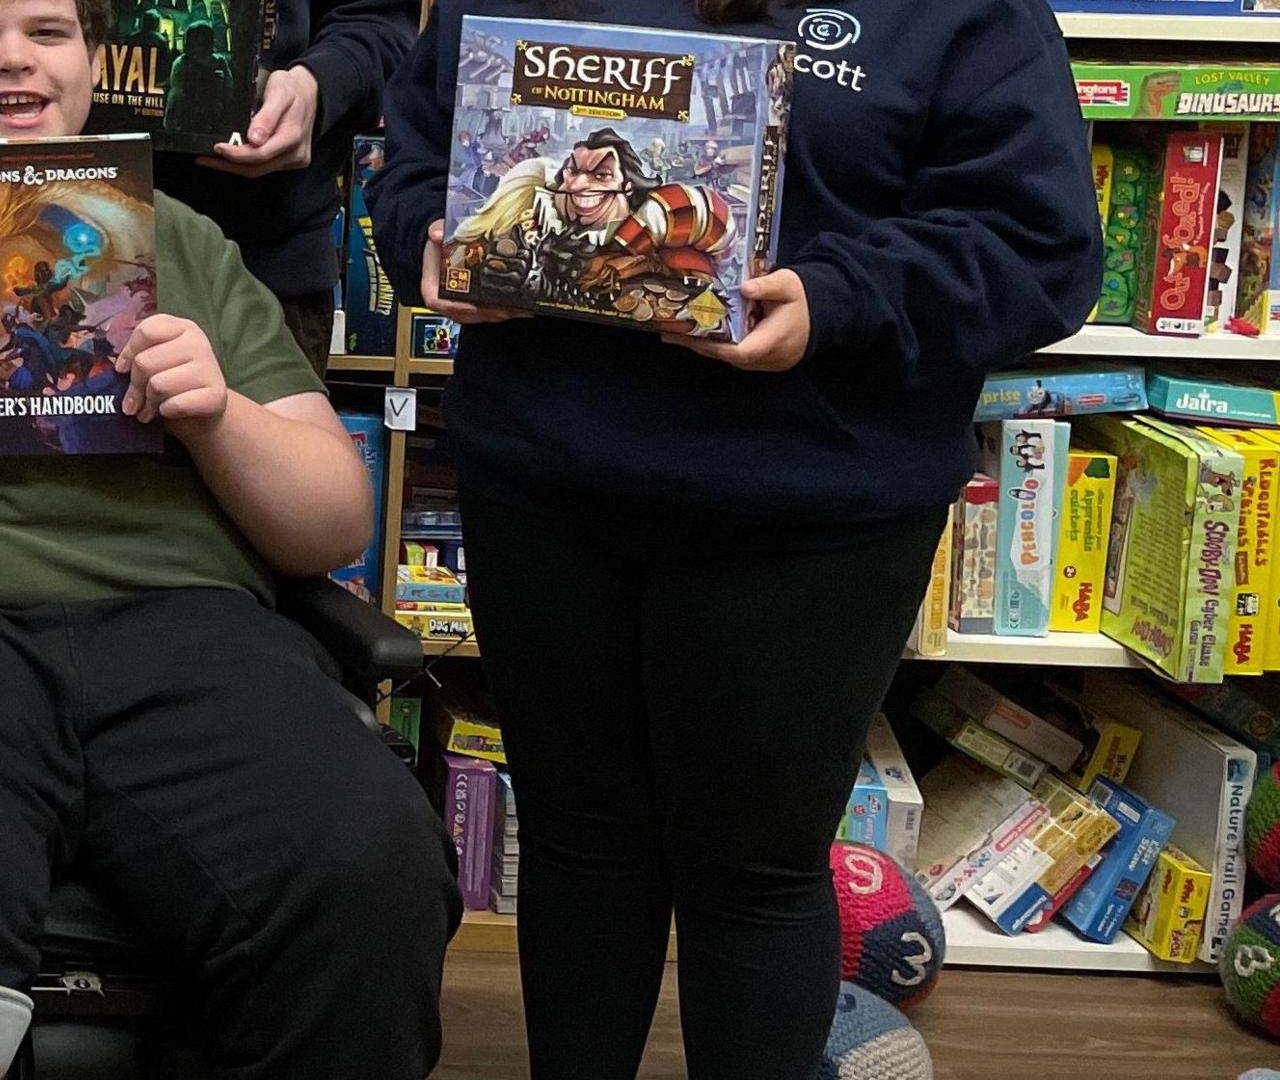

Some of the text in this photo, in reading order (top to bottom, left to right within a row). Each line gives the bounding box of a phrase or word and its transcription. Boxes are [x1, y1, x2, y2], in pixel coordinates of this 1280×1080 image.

[1194, 70, 1271, 87] LOST VALLEY
[112, 93, 126, 106] ON
[127, 94, 143, 107] THE
[144, 95, 165, 109] HILL
[544, 84, 666, 112] NOTTINGHAM
[1176, 93, 1280, 115] DINOSAURS
[22, 164, 45, 186] &
[44, 166, 119, 182] DRAGONS
[29, 394, 117, 417] HANDBOOK
[389, 397, 410, 417] V
[1072, 581, 1093, 623] HABA
[1232, 623, 1253, 665] HABA
[1215, 784, 1244, 938] Nature Trail Game
